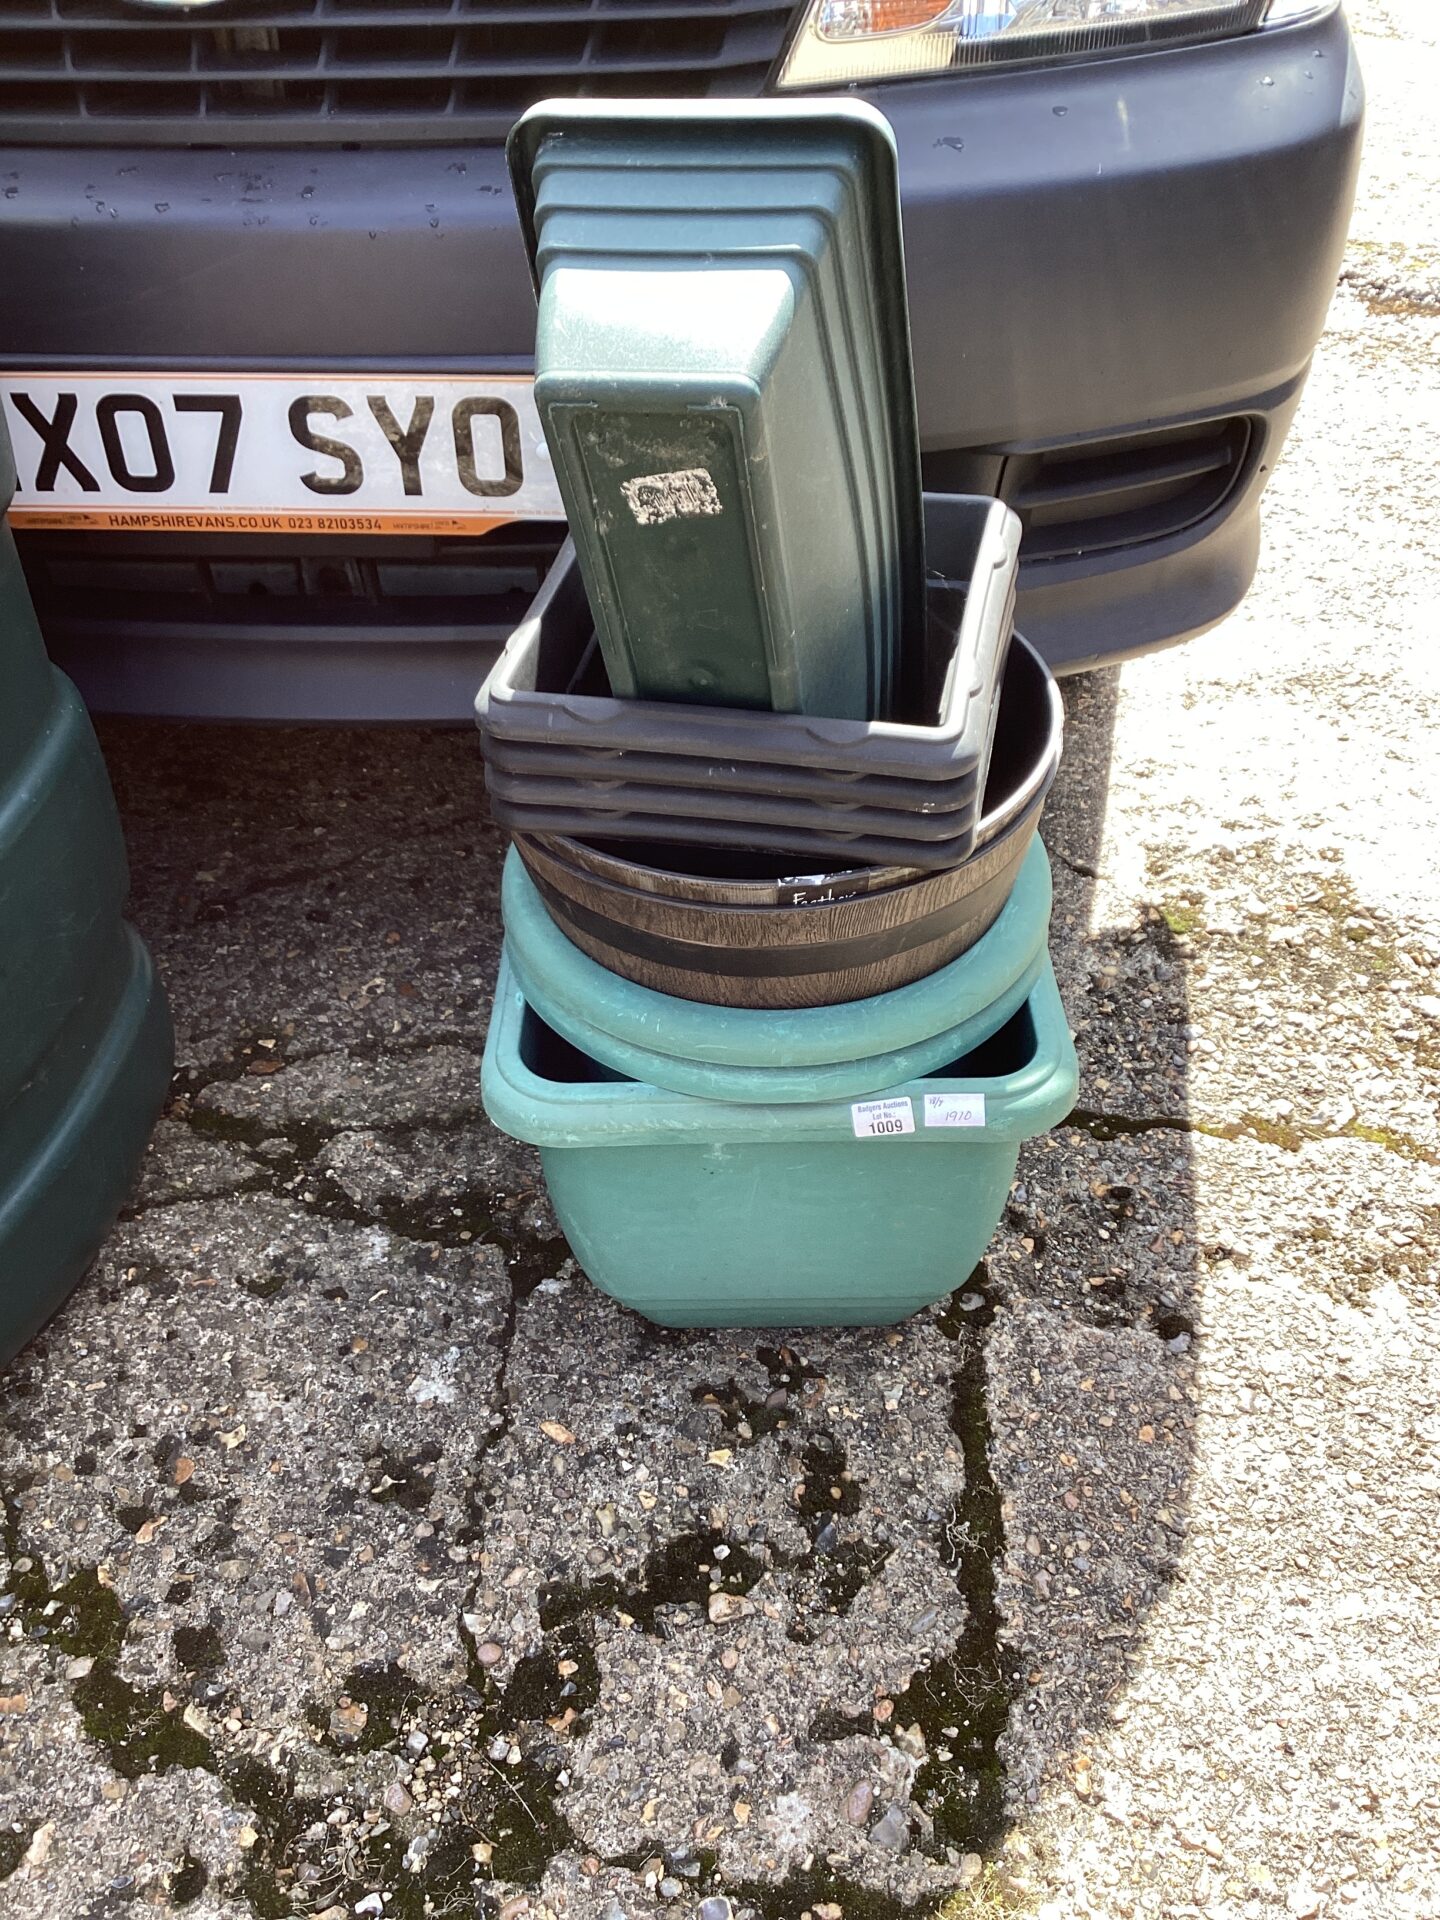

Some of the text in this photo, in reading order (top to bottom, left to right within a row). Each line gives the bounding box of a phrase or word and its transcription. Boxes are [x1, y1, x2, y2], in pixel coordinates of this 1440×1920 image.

[9, 391, 524, 497] X07 SYO
[108, 514, 283, 529] HAMPSHIREVANS.CO.UK
[287, 517, 314, 530] 023
[317, 517, 383, 531] 82103534
[857, 1100, 908, 1114] Badgers Auctions
[872, 1112, 882, 1121] Lot
[945, 1110, 972, 1121] 1910
[868, 1119, 903, 1135] 1009
